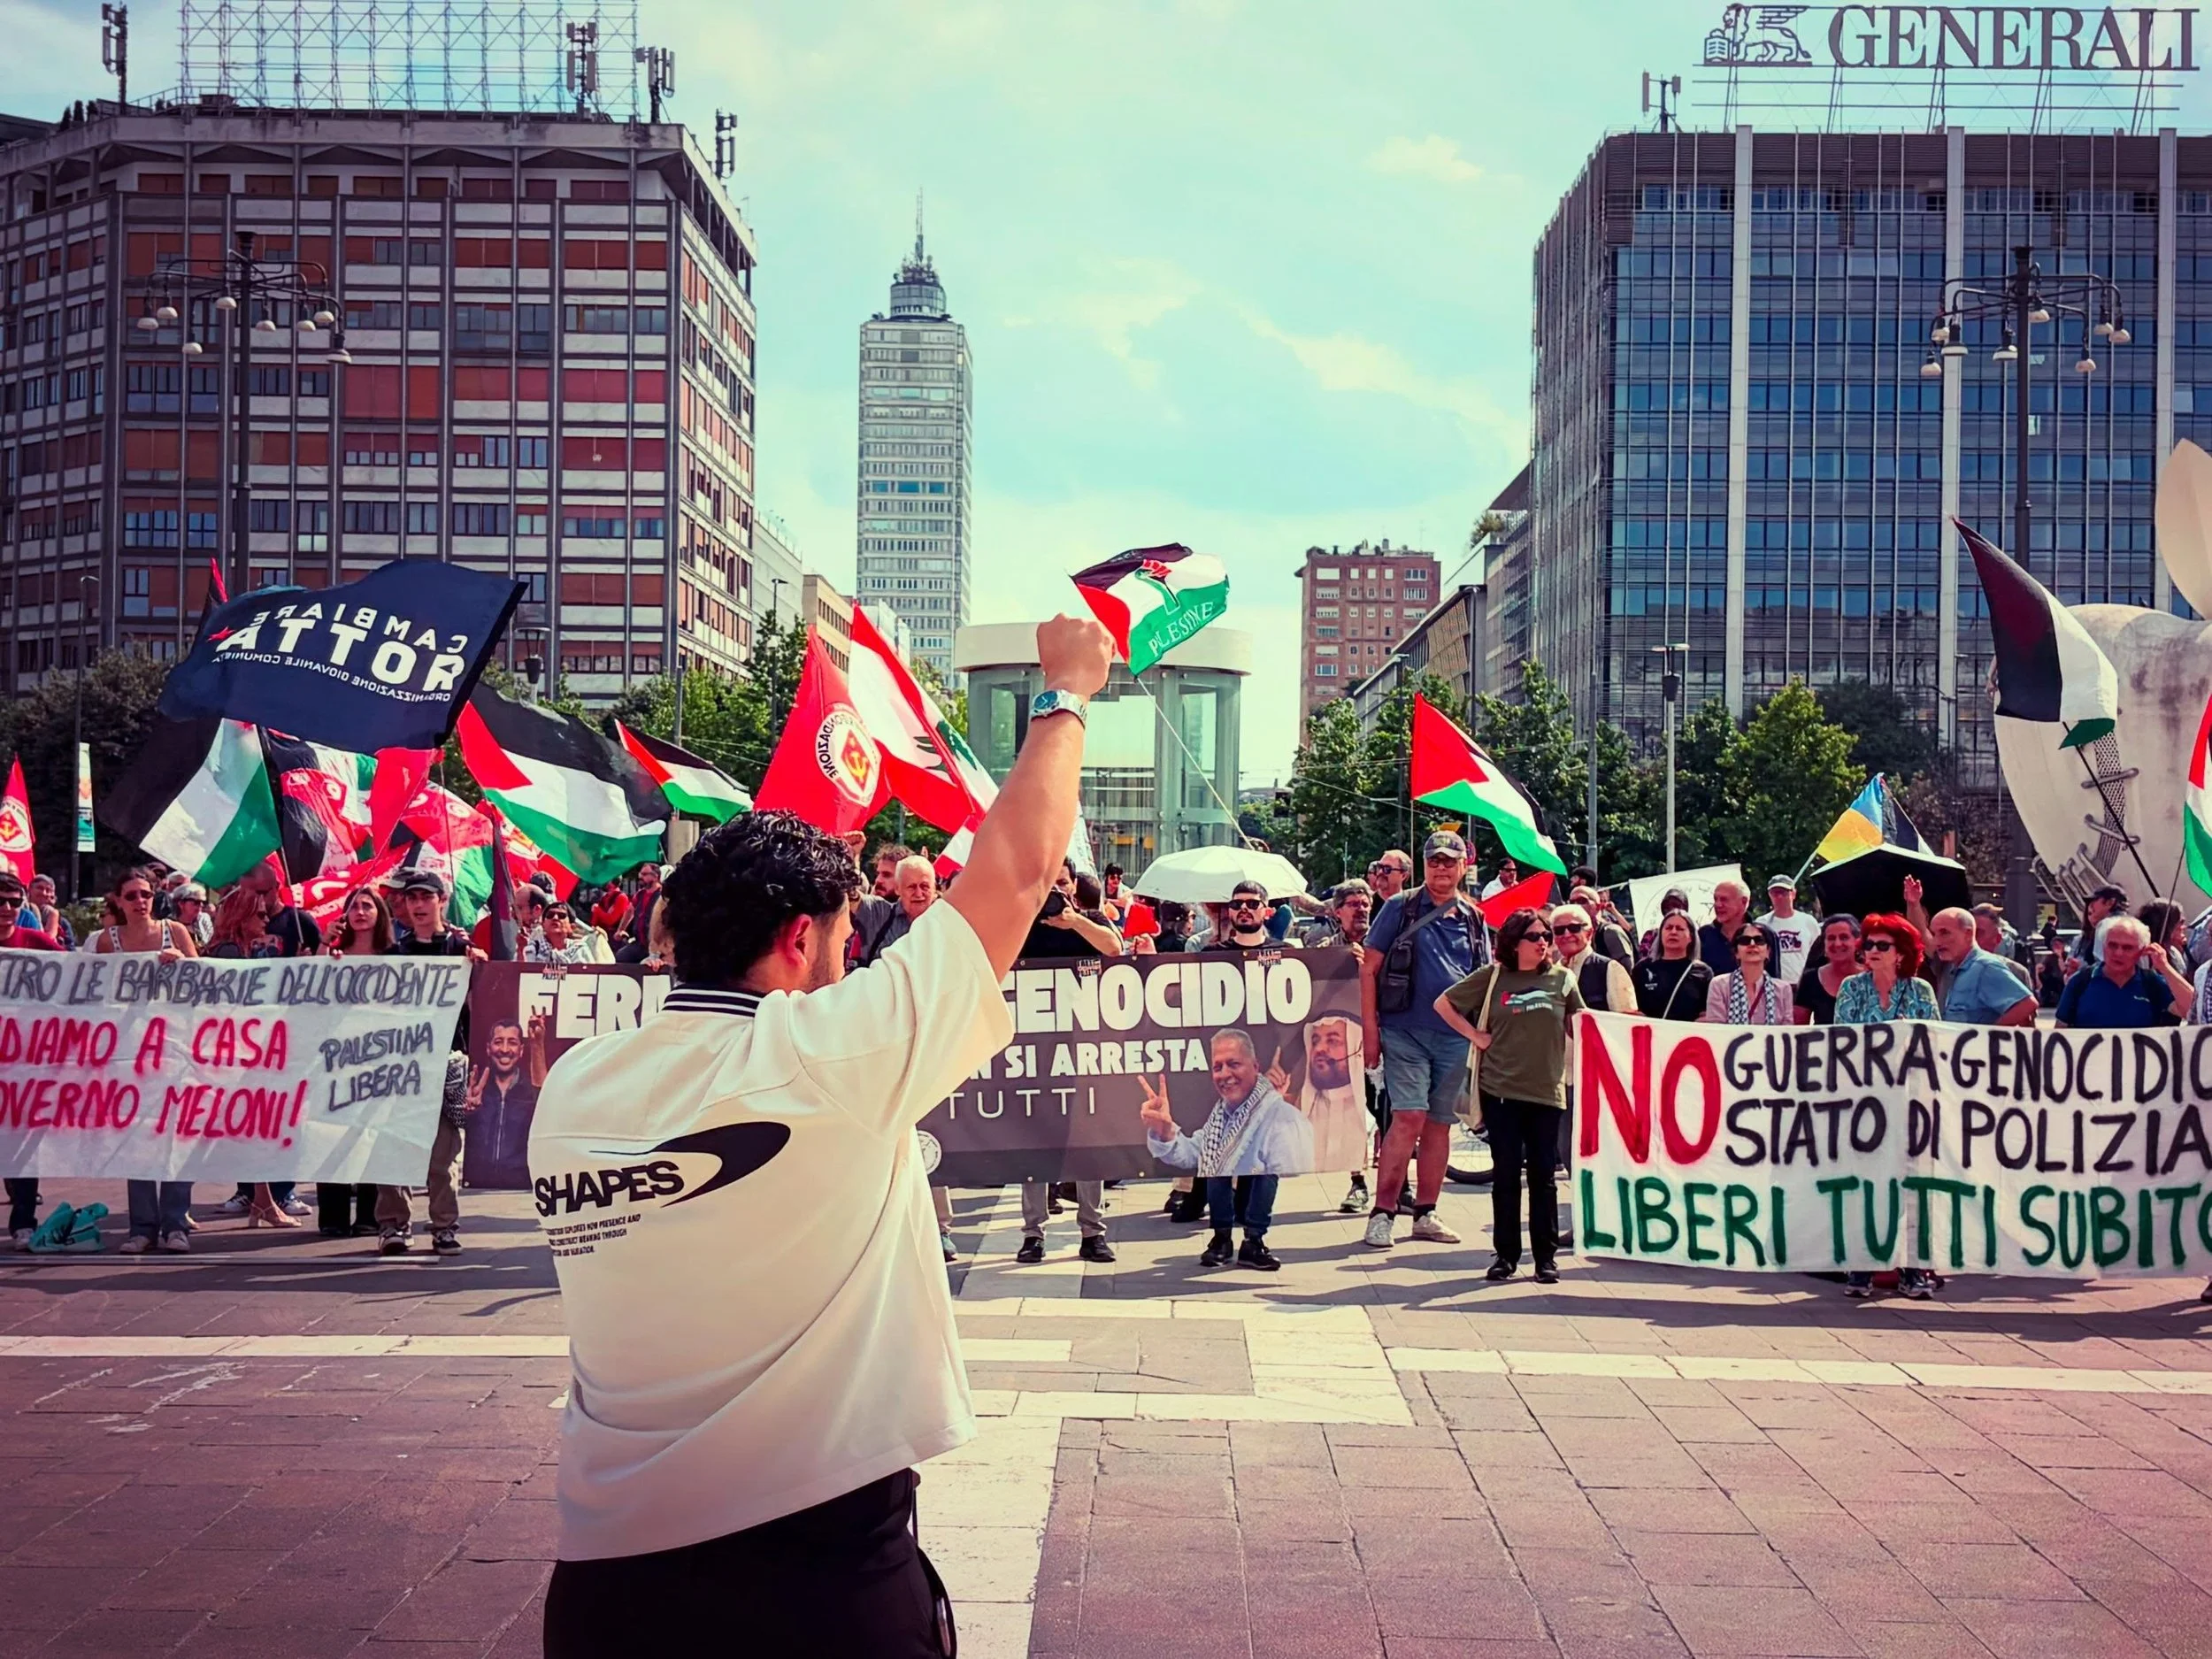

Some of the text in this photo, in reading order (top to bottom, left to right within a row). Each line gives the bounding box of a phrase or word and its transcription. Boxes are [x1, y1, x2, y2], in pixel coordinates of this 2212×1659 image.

[1828, 4, 2200, 71] GENERALI
[69, 961, 108, 1005] LE
[115, 959, 271, 1006] BARBARIE
[134, 1018, 167, 1074] A
[191, 1018, 288, 1071] CASA
[318, 1021, 434, 1073] PALESTINA
[1005, 1044, 1037, 1079] SI
[1050, 1039, 1210, 1078] ARRESTA
[156, 1079, 309, 1148] MELONI!
[327, 1060, 422, 1112] LIBERA
[947, 1087, 1096, 1121] TUTTI
[1579, 1013, 1722, 1164] NO
[1724, 1097, 2212, 1175] STATO DI POLIZIA
[534, 1160, 685, 1217] SHAPES
[1580, 1170, 1786, 1267] LIBERI
[1816, 1175, 1996, 1268] TUTTI
